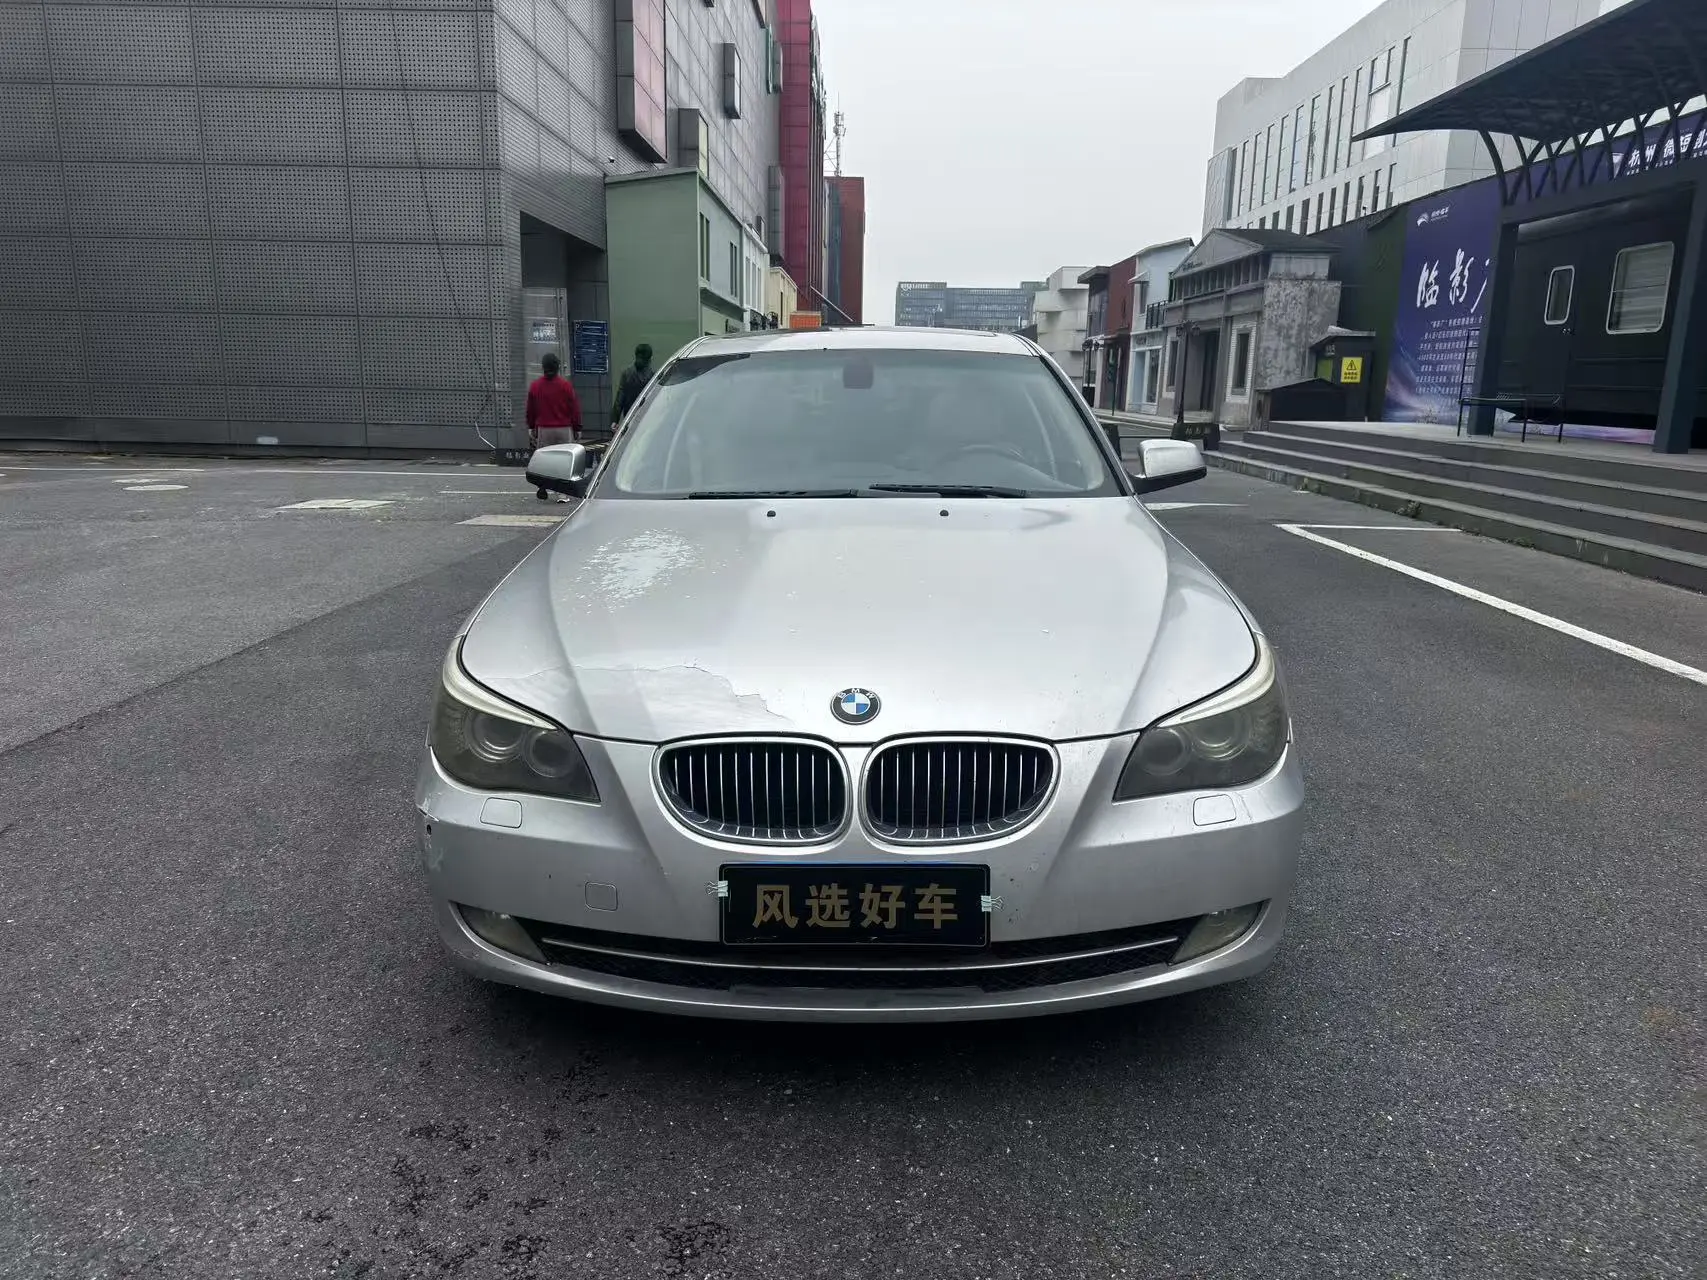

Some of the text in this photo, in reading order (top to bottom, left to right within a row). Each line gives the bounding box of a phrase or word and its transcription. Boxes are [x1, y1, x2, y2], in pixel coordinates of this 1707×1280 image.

[837, 688, 876, 699] BMW
[751, 882, 959, 930] 风选好车
